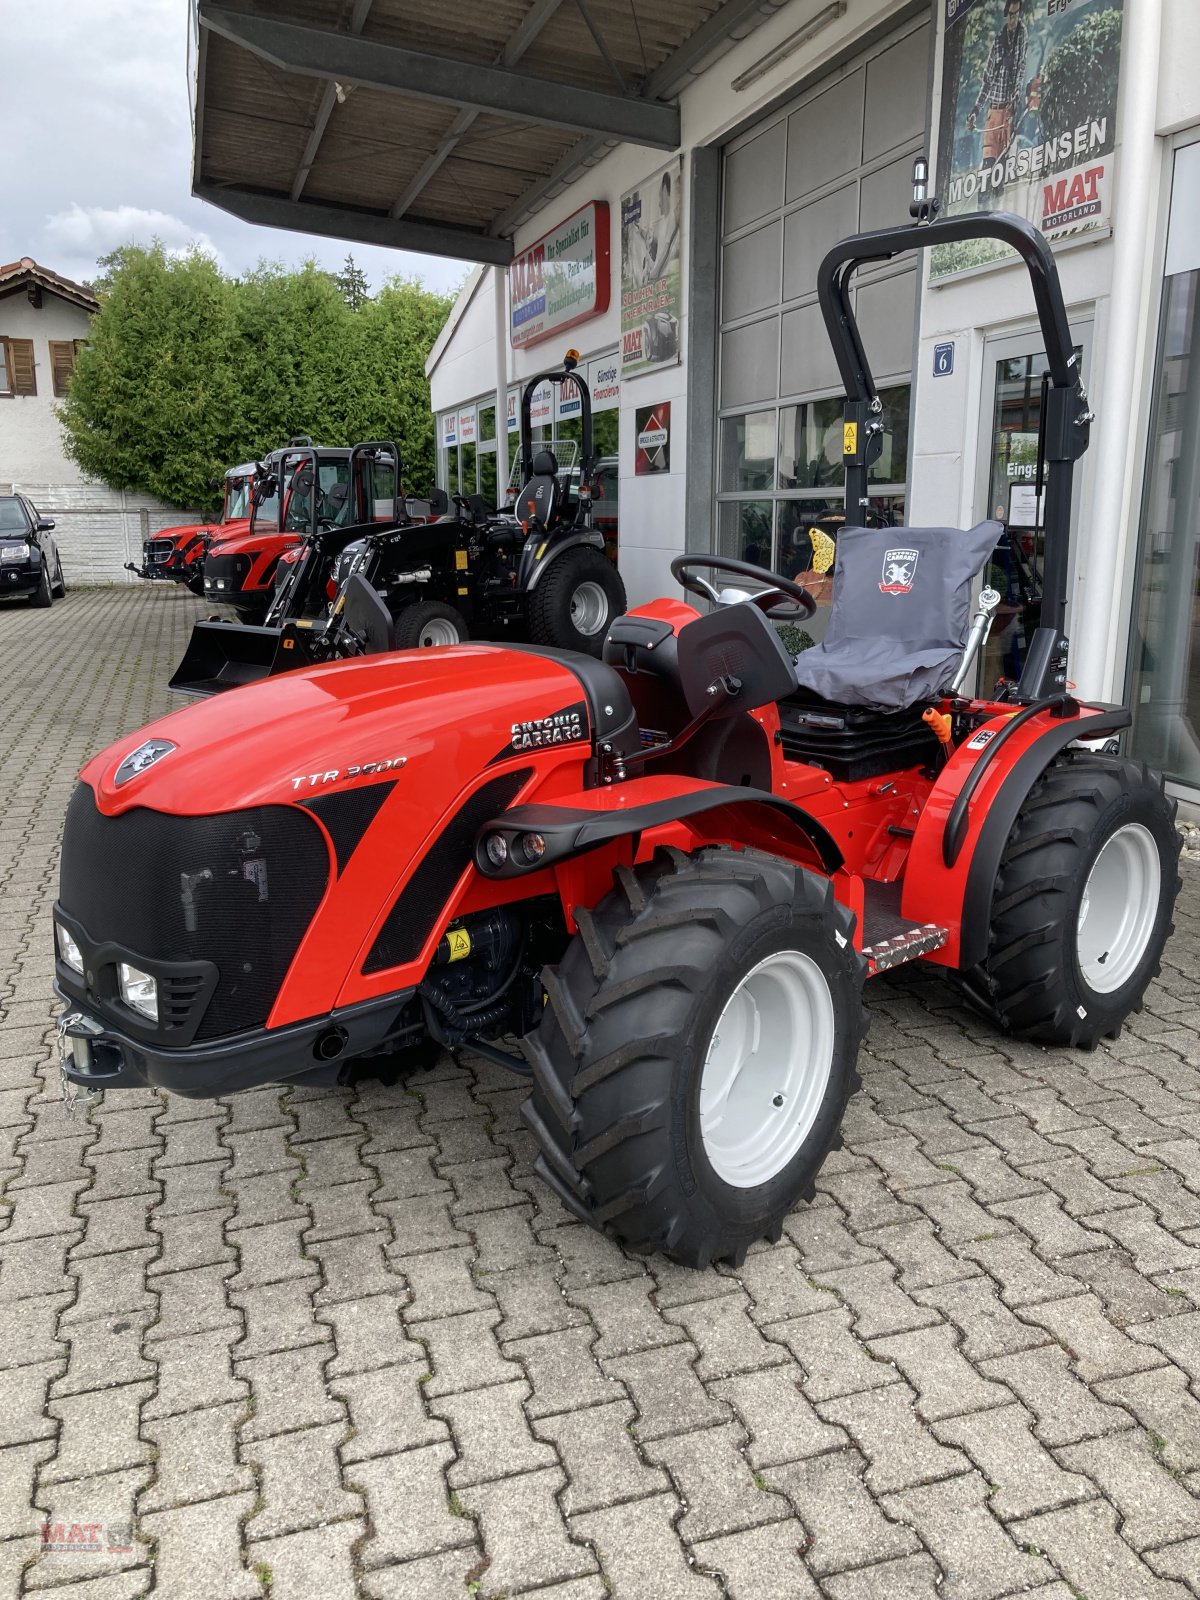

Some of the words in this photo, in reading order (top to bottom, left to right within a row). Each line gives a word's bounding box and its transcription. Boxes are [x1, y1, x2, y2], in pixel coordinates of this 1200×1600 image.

[948, 117, 1108, 204] MOTORSENSEN
[1043, 166, 1104, 217] MAT
[1046, 204, 1096, 228] MOTORLAND
[555, 227, 580, 256] Spezialist
[511, 243, 545, 304] MAT
[623, 330, 642, 355] MAT
[597, 365, 617, 383] Günstige
[939, 352, 947, 371] 6
[511, 713, 580, 734] ANTONIO
[511, 724, 582, 750] CARRARO
[291, 769, 340, 789] TTR
